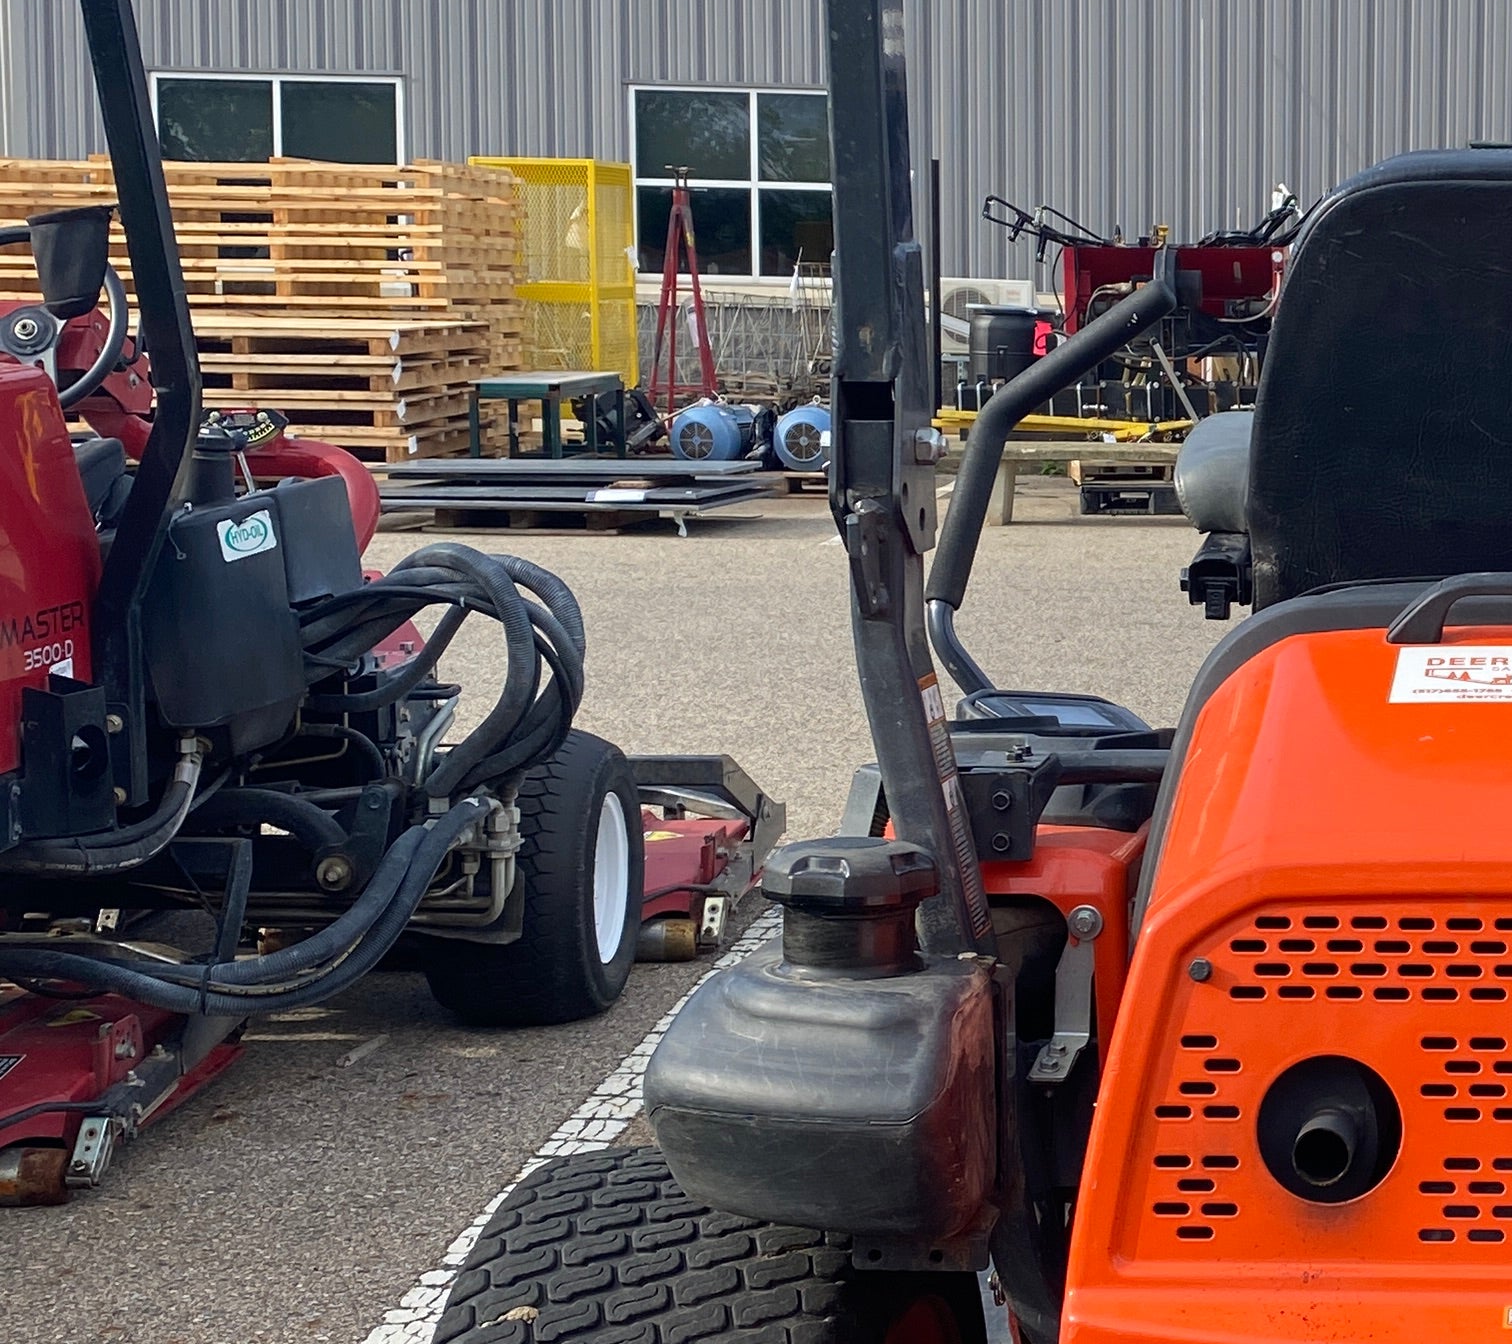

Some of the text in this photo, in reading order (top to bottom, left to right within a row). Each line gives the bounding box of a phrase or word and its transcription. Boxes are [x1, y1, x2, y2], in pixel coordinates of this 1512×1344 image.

[230, 523, 264, 546] HYD-OIL
[23, 639, 74, 671] 3500-D
[1426, 657, 1510, 666] DEER
